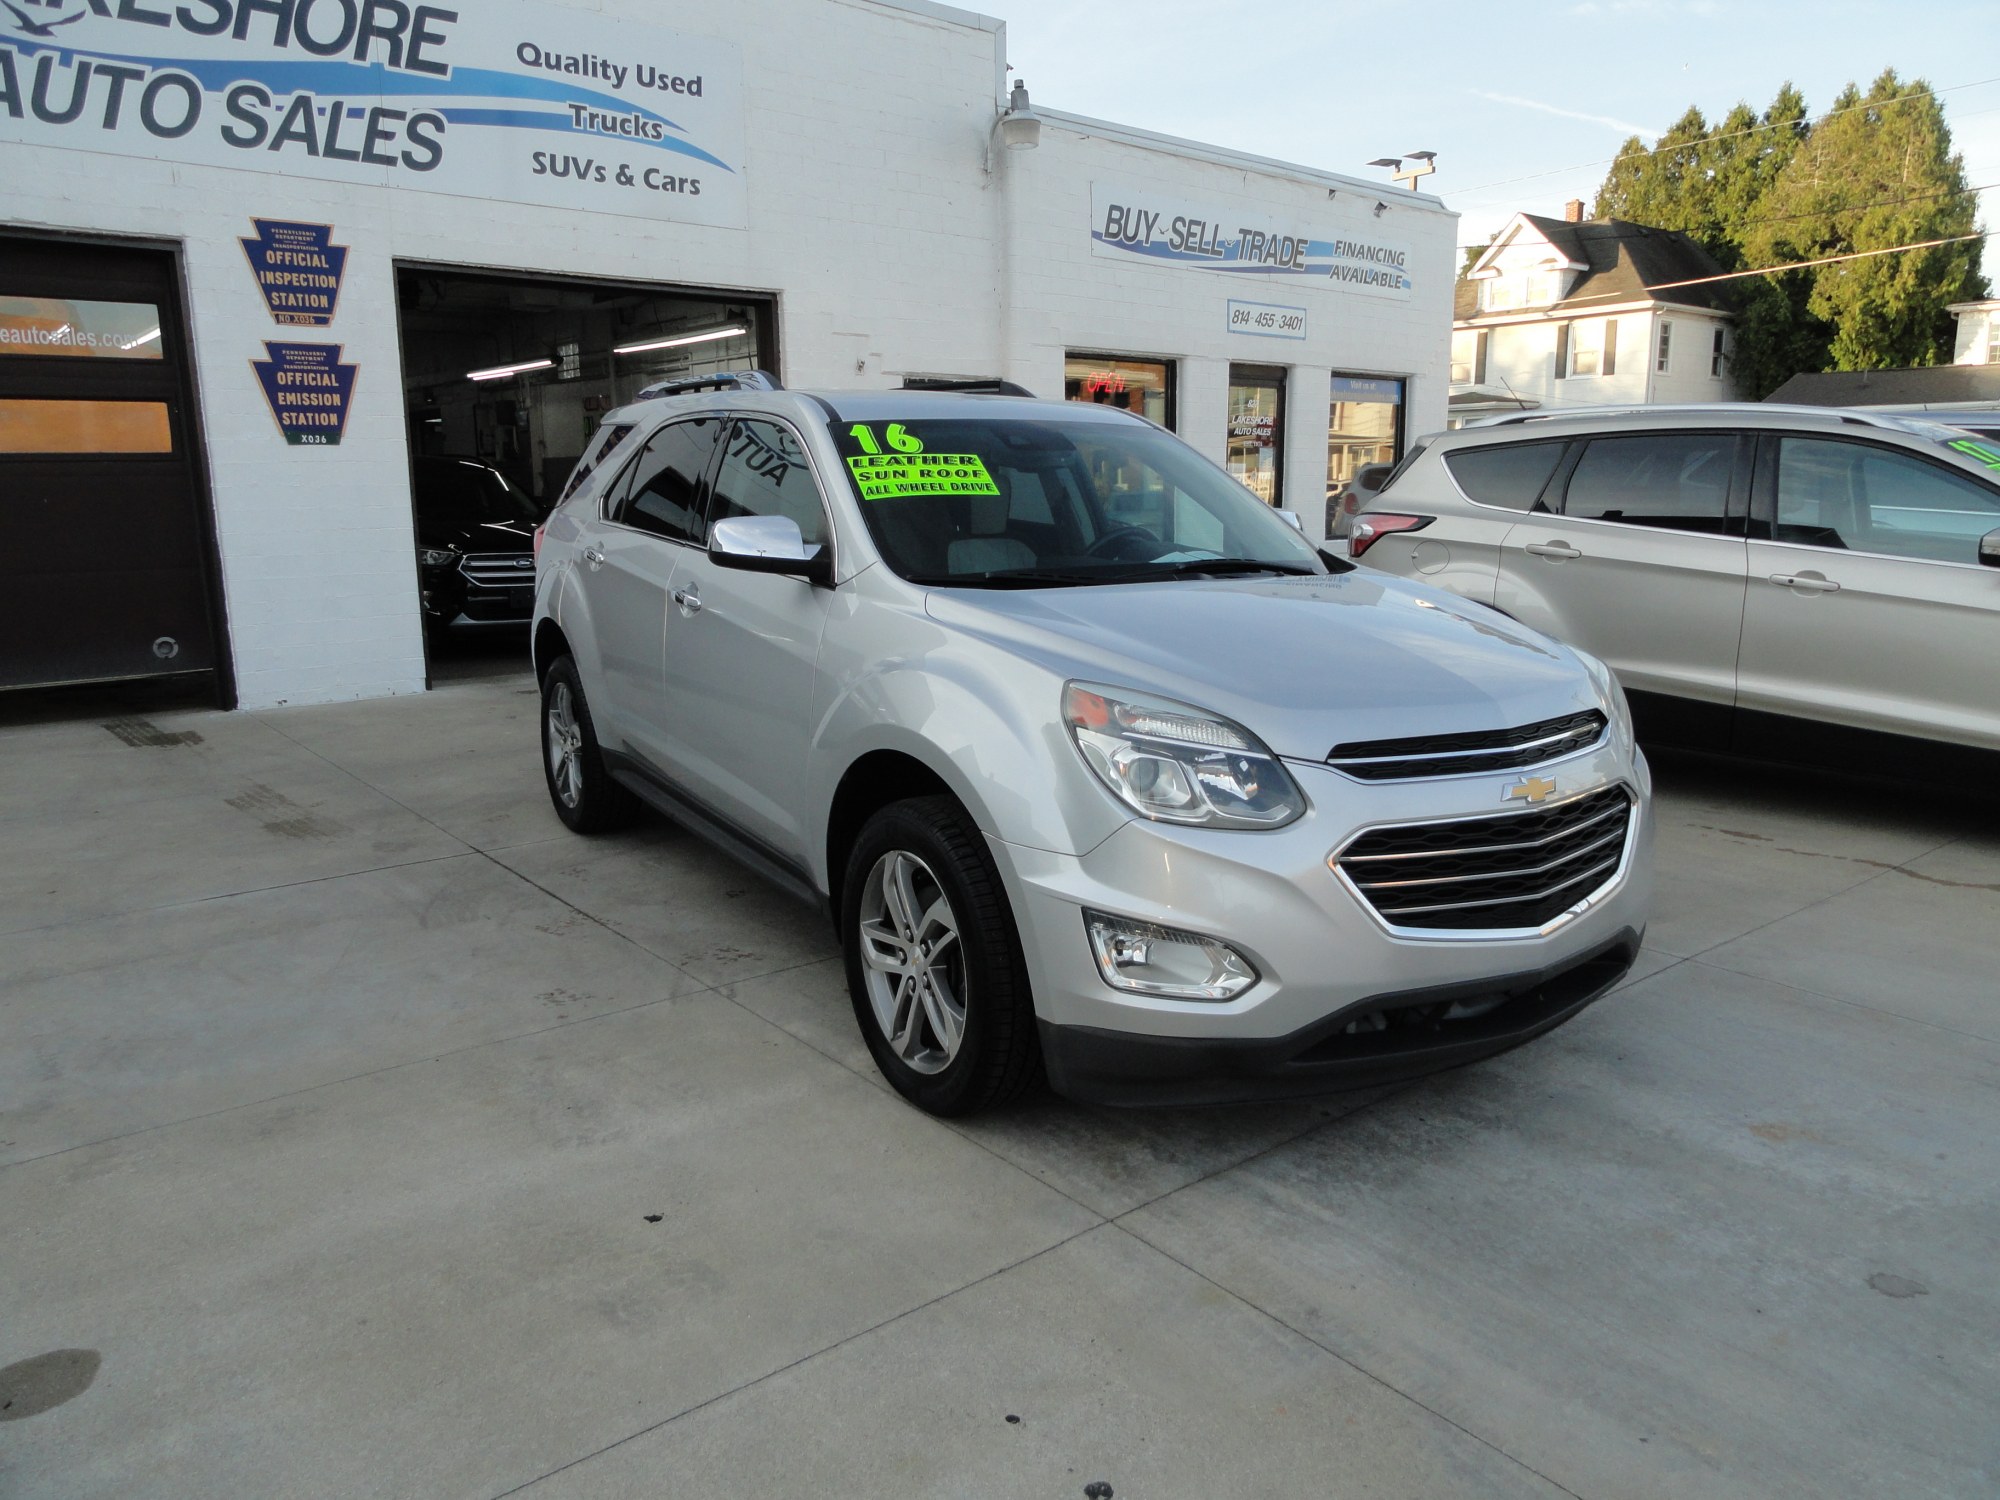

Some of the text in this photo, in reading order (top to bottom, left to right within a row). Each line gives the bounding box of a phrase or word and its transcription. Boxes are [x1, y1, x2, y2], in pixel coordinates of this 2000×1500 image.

[24, 0, 458, 76] SHORE
[516, 42, 702, 97] Quality Used
[220, 85, 446, 171] SALES
[568, 103, 662, 139] Trucks
[532, 151, 700, 195] SUVs & Cars
[1104, 204, 1308, 269] BUY SELL TRADE
[266, 250, 329, 268] OFFICIAL
[1333, 240, 1405, 267] FINANCING
[260, 271, 336, 288] INSPECTION
[1329, 265, 1402, 289] AVAILABLE
[271, 291, 328, 308] STATION
[1231, 309, 1303, 330] 814-455-3401
[277, 371, 339, 386] OFFICIAL
[1087, 372, 1125, 393] OPEN
[277, 392, 341, 406] EMISSION
[282, 412, 338, 426] STATION
[1232, 415, 1274, 425] LAKESHORE
[301, 434, 327, 443] X036
[850, 423, 924, 454] 16
[1234, 427, 1271, 436] AUTO SALES
[852, 455, 978, 469] LEATHER
[858, 469, 984, 482] SUN ROOF
[865, 482, 995, 496] ALL WHEEL DRIVE
